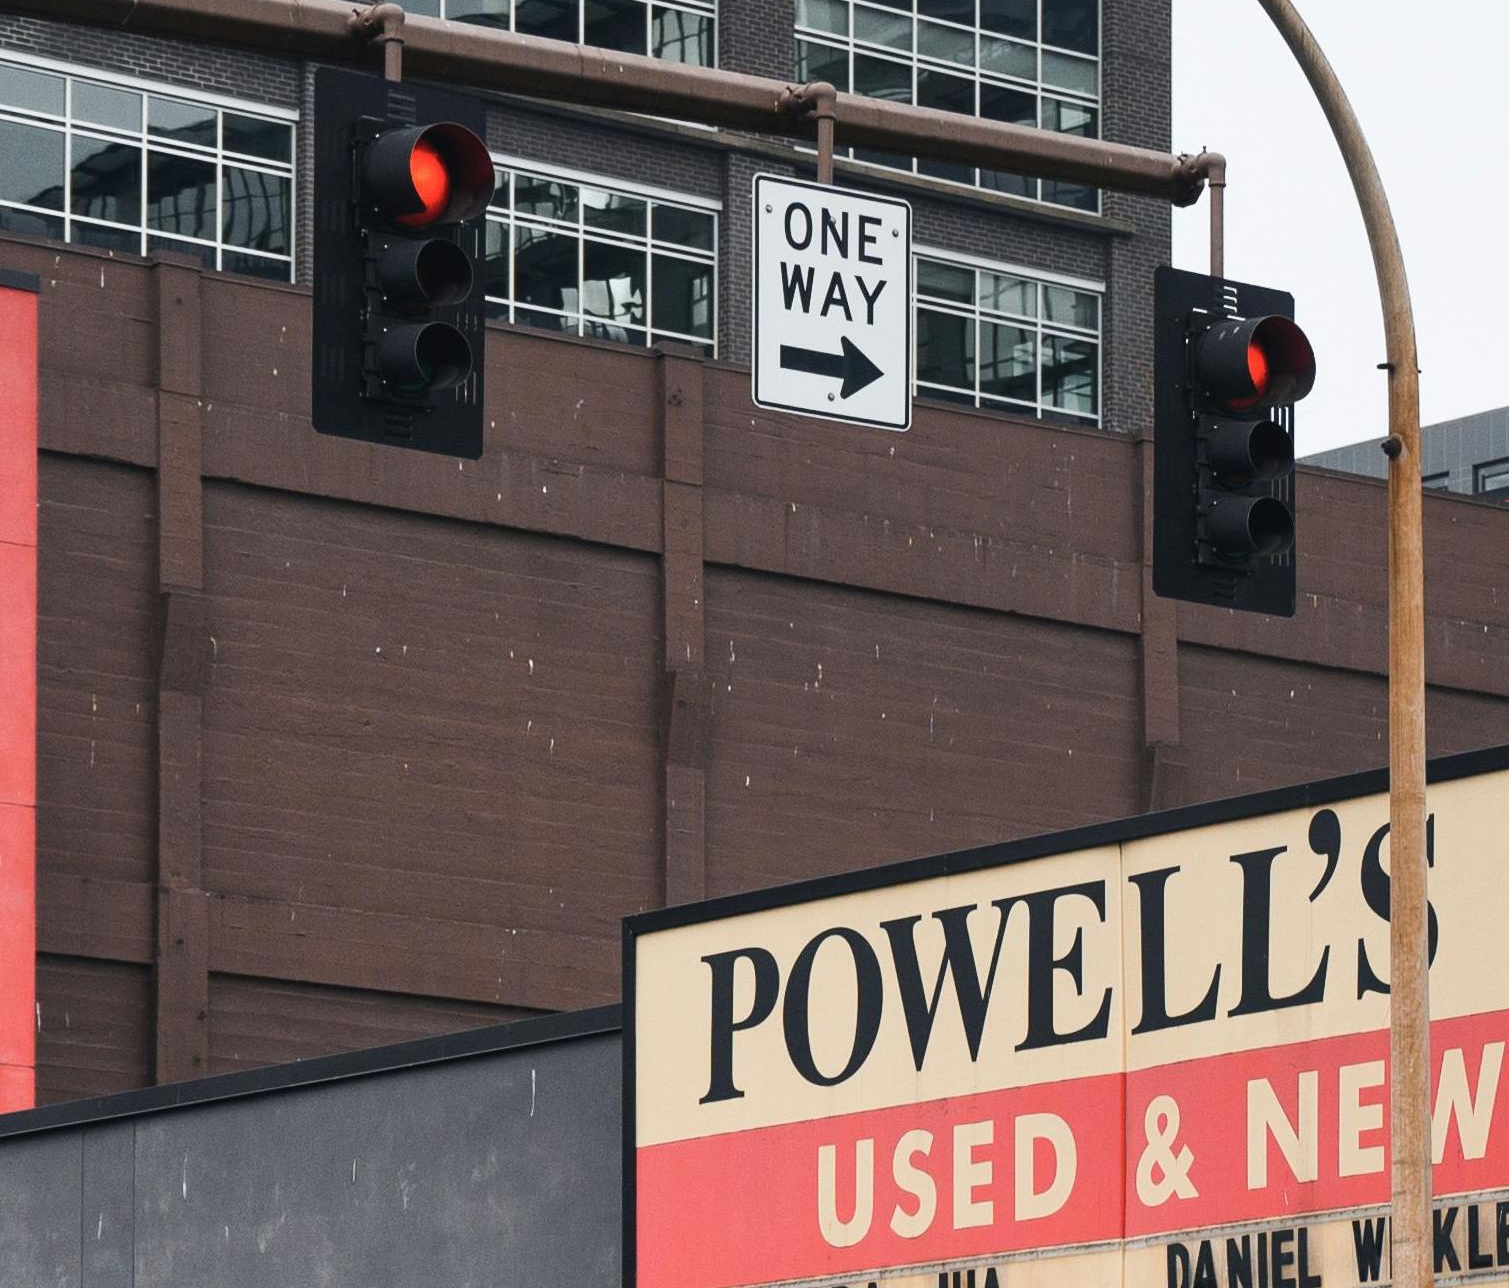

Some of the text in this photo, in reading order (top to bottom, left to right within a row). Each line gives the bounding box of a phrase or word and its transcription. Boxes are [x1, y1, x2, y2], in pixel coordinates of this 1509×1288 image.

[780, 261, 887, 326] WAY
[784, 201, 883, 266] ONE
[699, 808, 1439, 1105] POWELL'S
[816, 1113, 1078, 1250] USED
[1135, 1095, 1199, 1208] &
[1247, 1040, 1506, 1191] NEW
